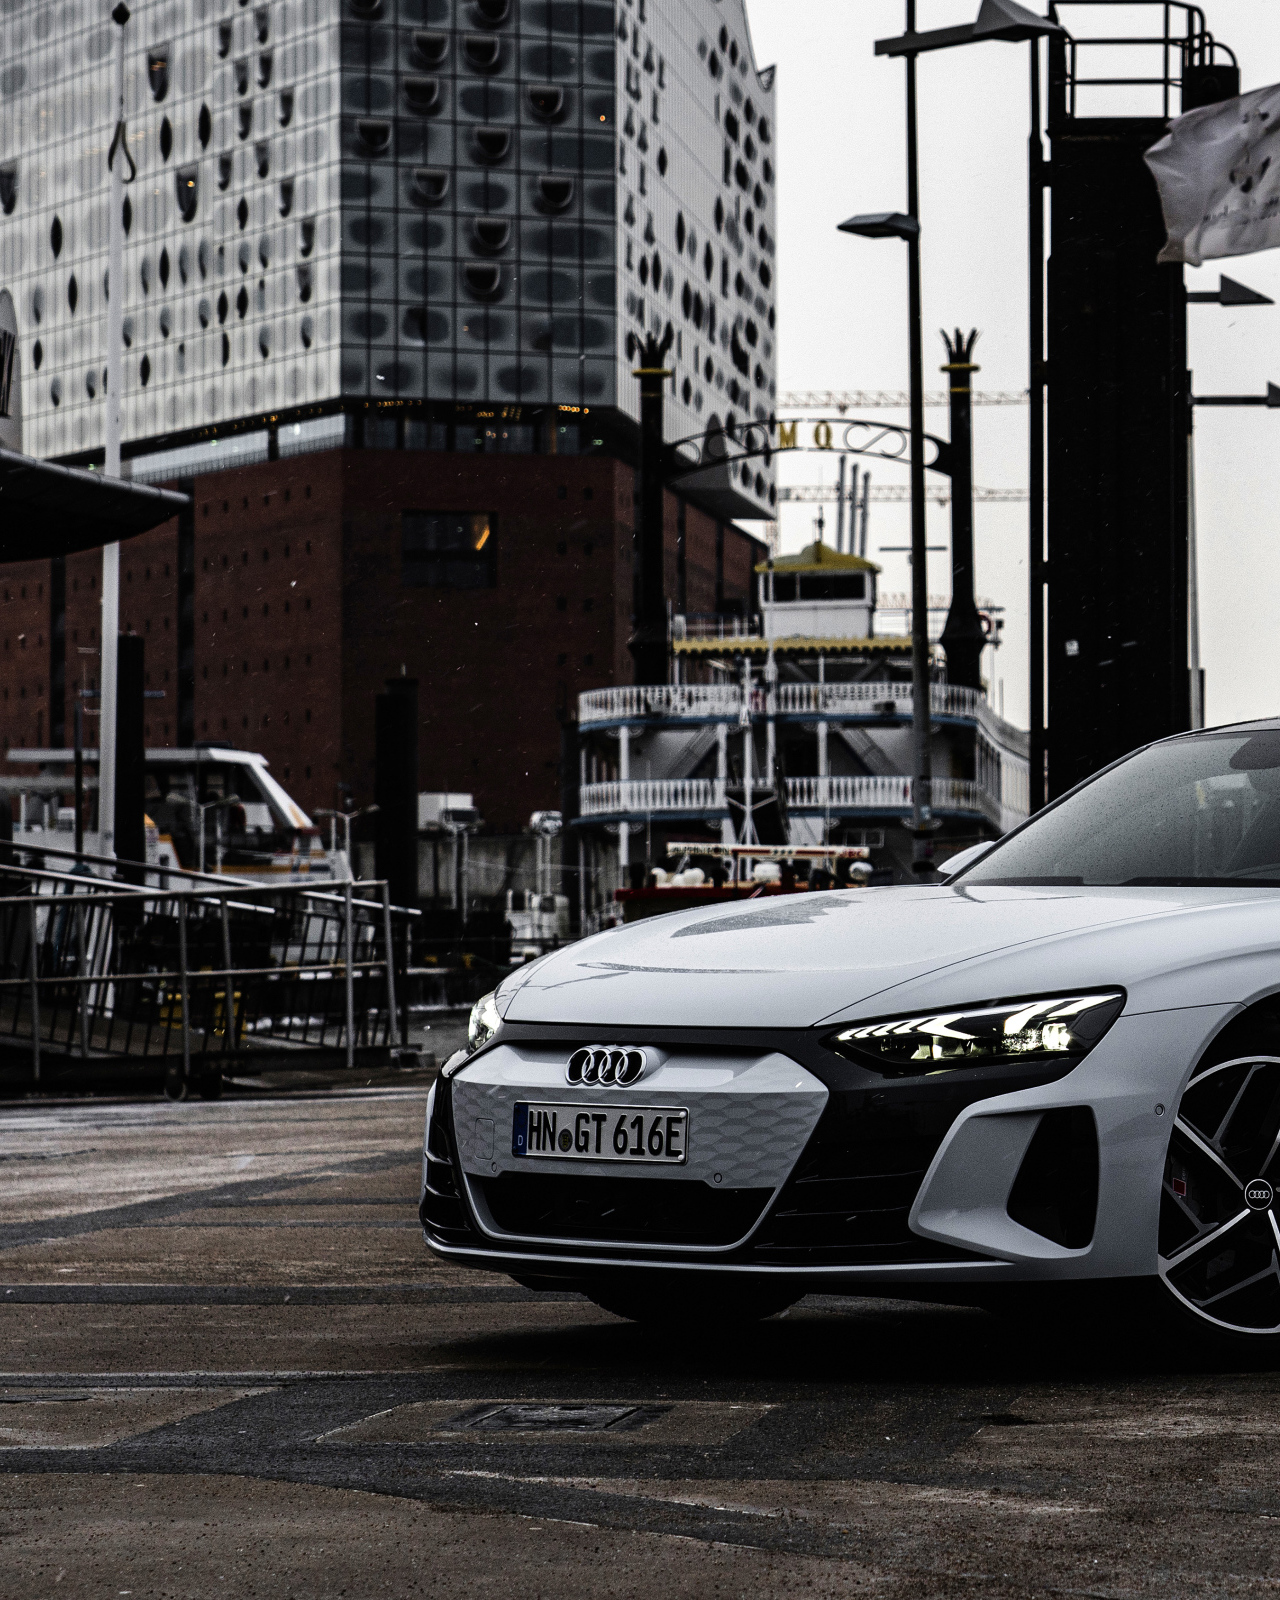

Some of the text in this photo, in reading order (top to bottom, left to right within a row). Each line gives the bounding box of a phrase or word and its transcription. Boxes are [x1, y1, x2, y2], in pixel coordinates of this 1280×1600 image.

[527, 1109, 683, 1158] HN GT 616E
